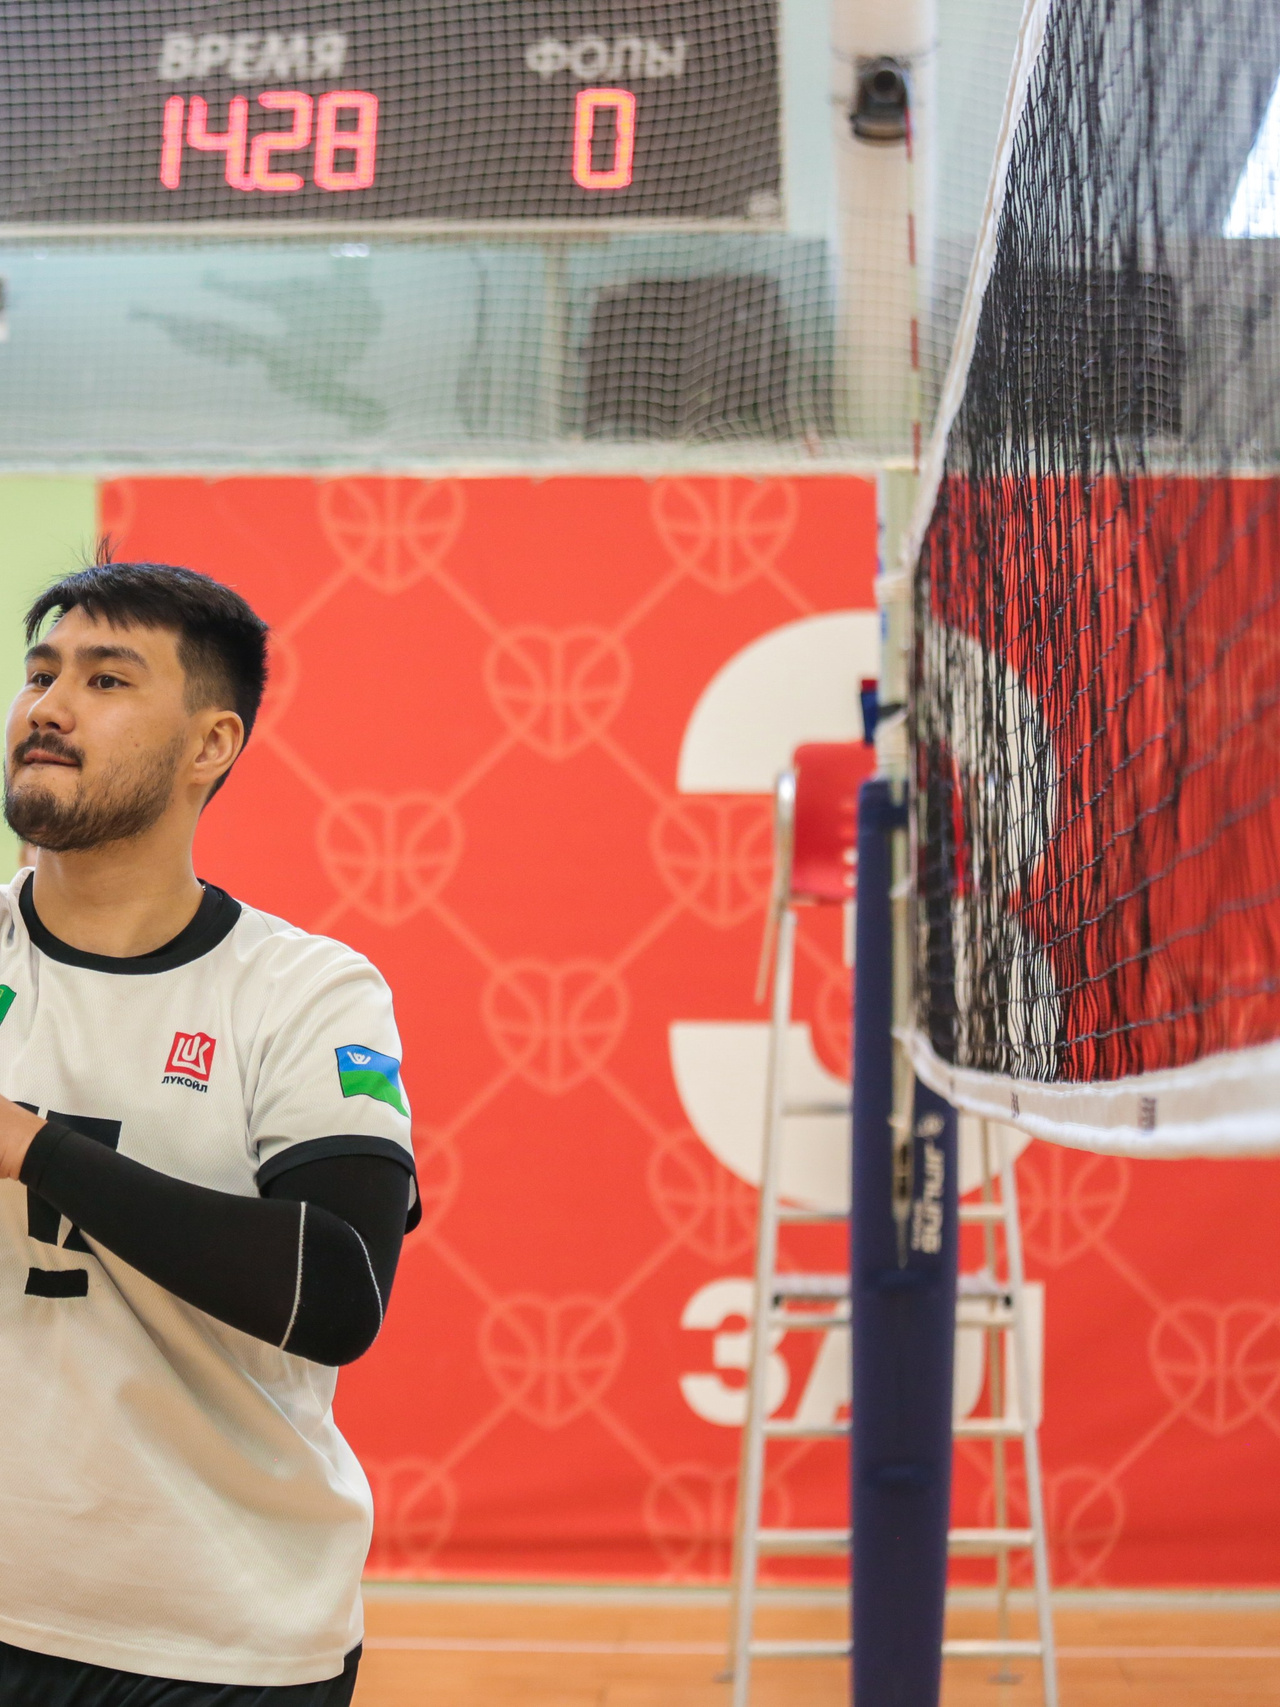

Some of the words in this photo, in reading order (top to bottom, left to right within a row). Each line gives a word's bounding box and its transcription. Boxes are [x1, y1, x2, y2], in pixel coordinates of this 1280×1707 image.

[159, 31, 347, 80] ВРЕМЯ
[525, 35, 687, 79] ФОЛЫ
[573, 88, 636, 189] 0
[161, 1075, 208, 1093] ЛУКОЙЛ
